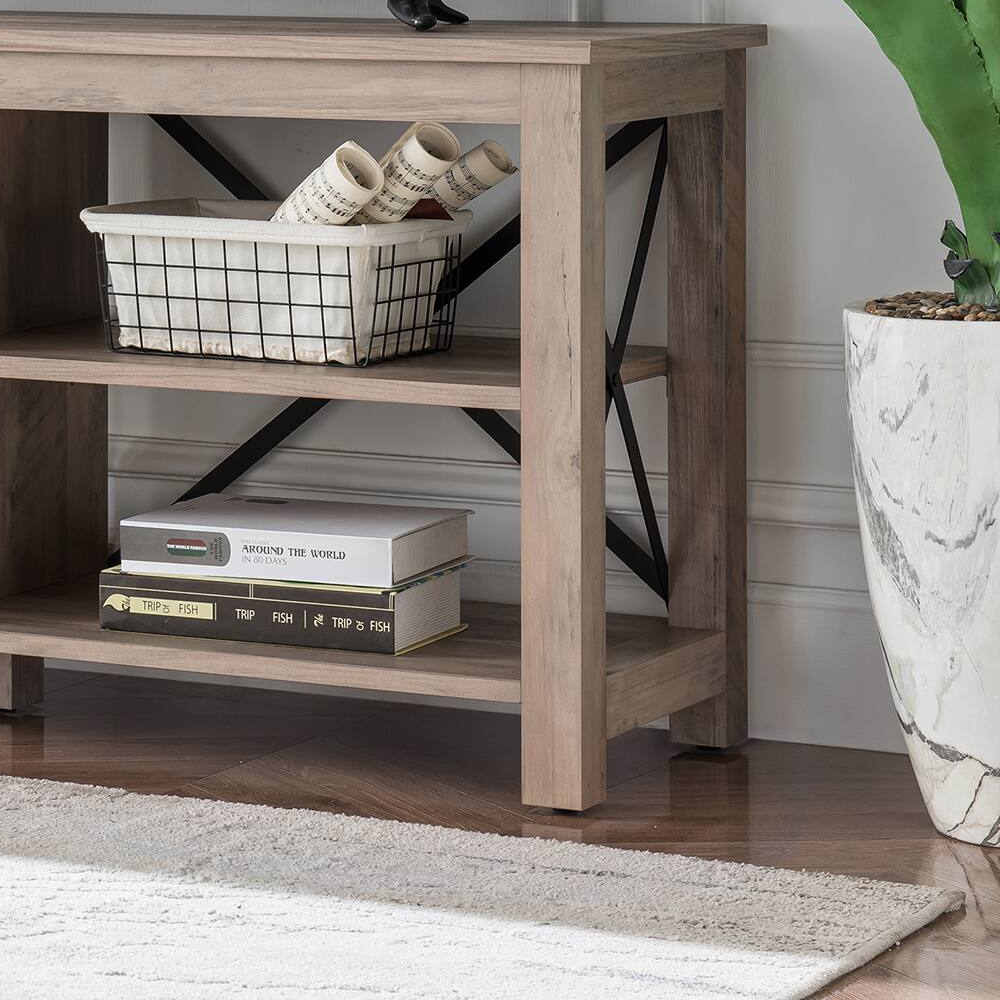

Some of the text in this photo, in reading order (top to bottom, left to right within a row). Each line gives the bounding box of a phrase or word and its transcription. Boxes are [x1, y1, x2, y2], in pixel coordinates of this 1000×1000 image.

[242, 544, 346, 560] AROUND THE WORLD
[241, 555, 287, 566] IN 80 DAYS
[142, 600, 161, 612] TRIP
[178, 603, 199, 615] FISH
[235, 608, 256, 621] TRIP
[272, 611, 293, 624] FISH
[331, 616, 353, 630] TRIP
[370, 620, 391, 633] FISH
